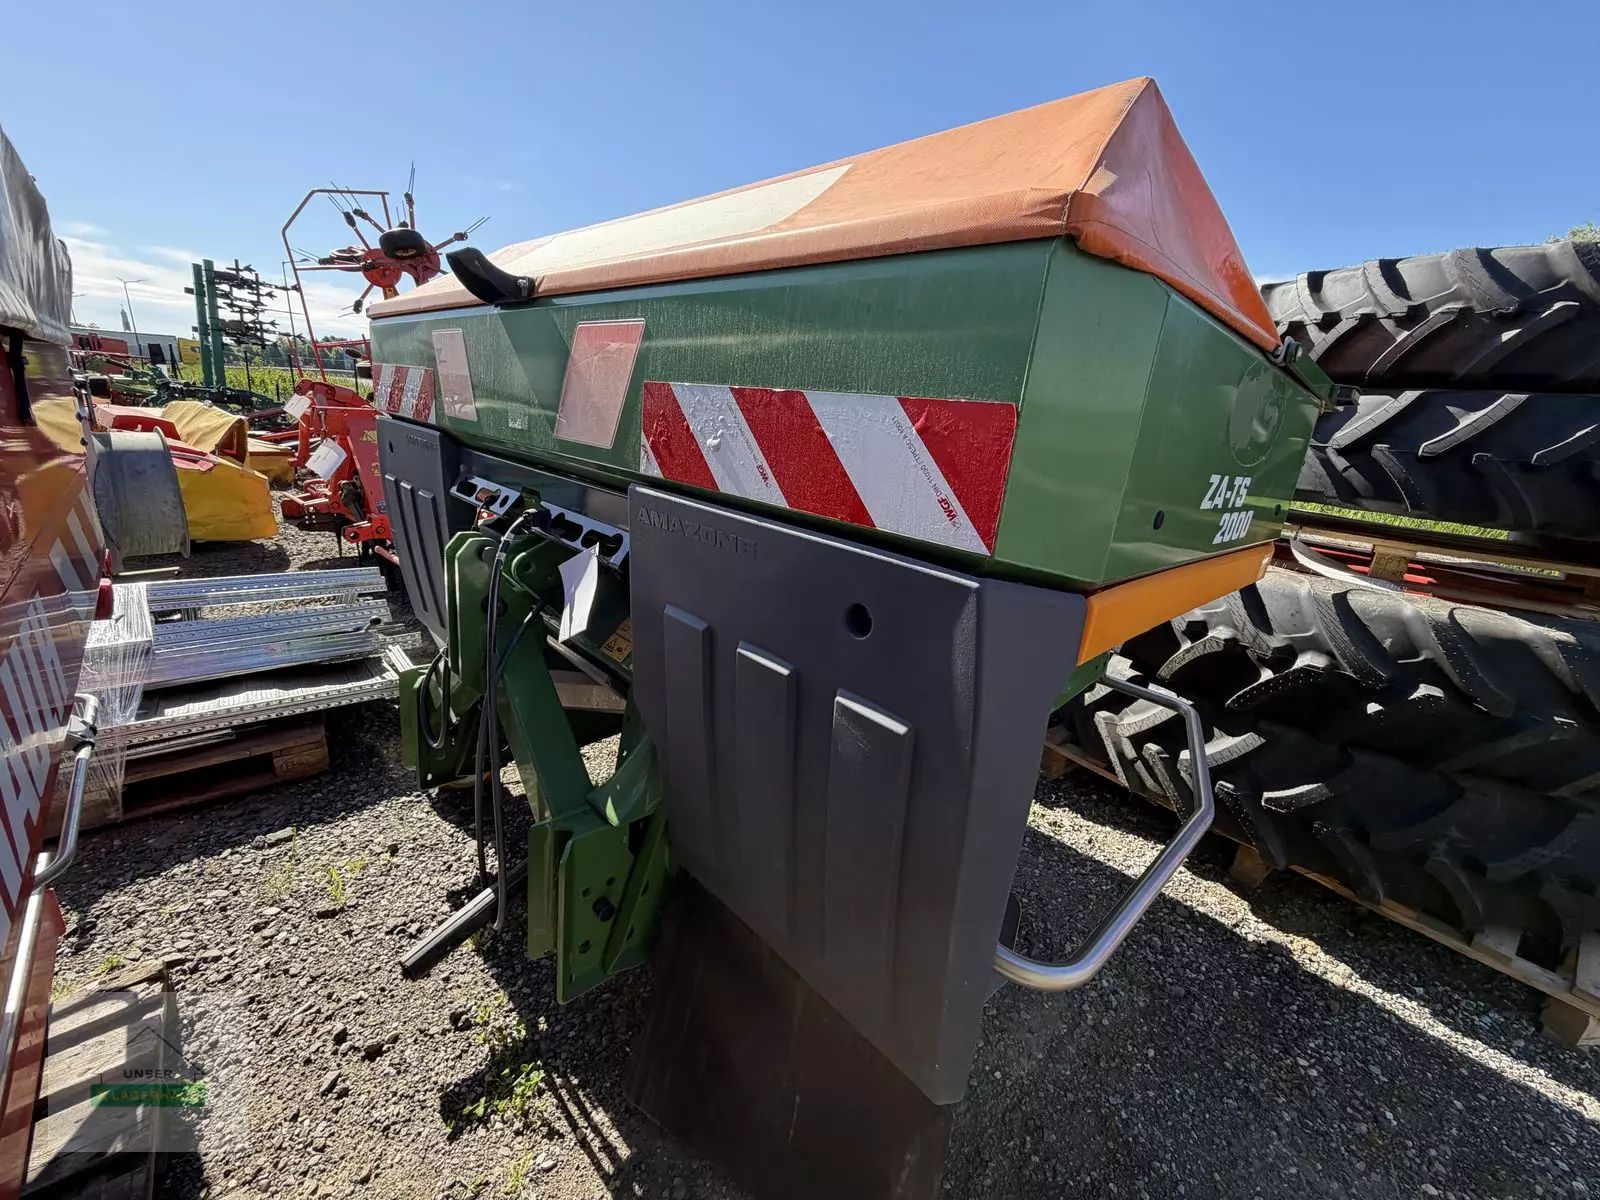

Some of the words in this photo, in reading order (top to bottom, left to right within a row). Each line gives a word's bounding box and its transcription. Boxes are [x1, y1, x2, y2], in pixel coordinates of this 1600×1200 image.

[931, 483, 943, 498] DIN
[1200, 474, 1252, 510] ZA-TS
[937, 496, 957, 522] WGF
[637, 507, 757, 560] AMAZONE
[1212, 510, 1254, 545] 2000
